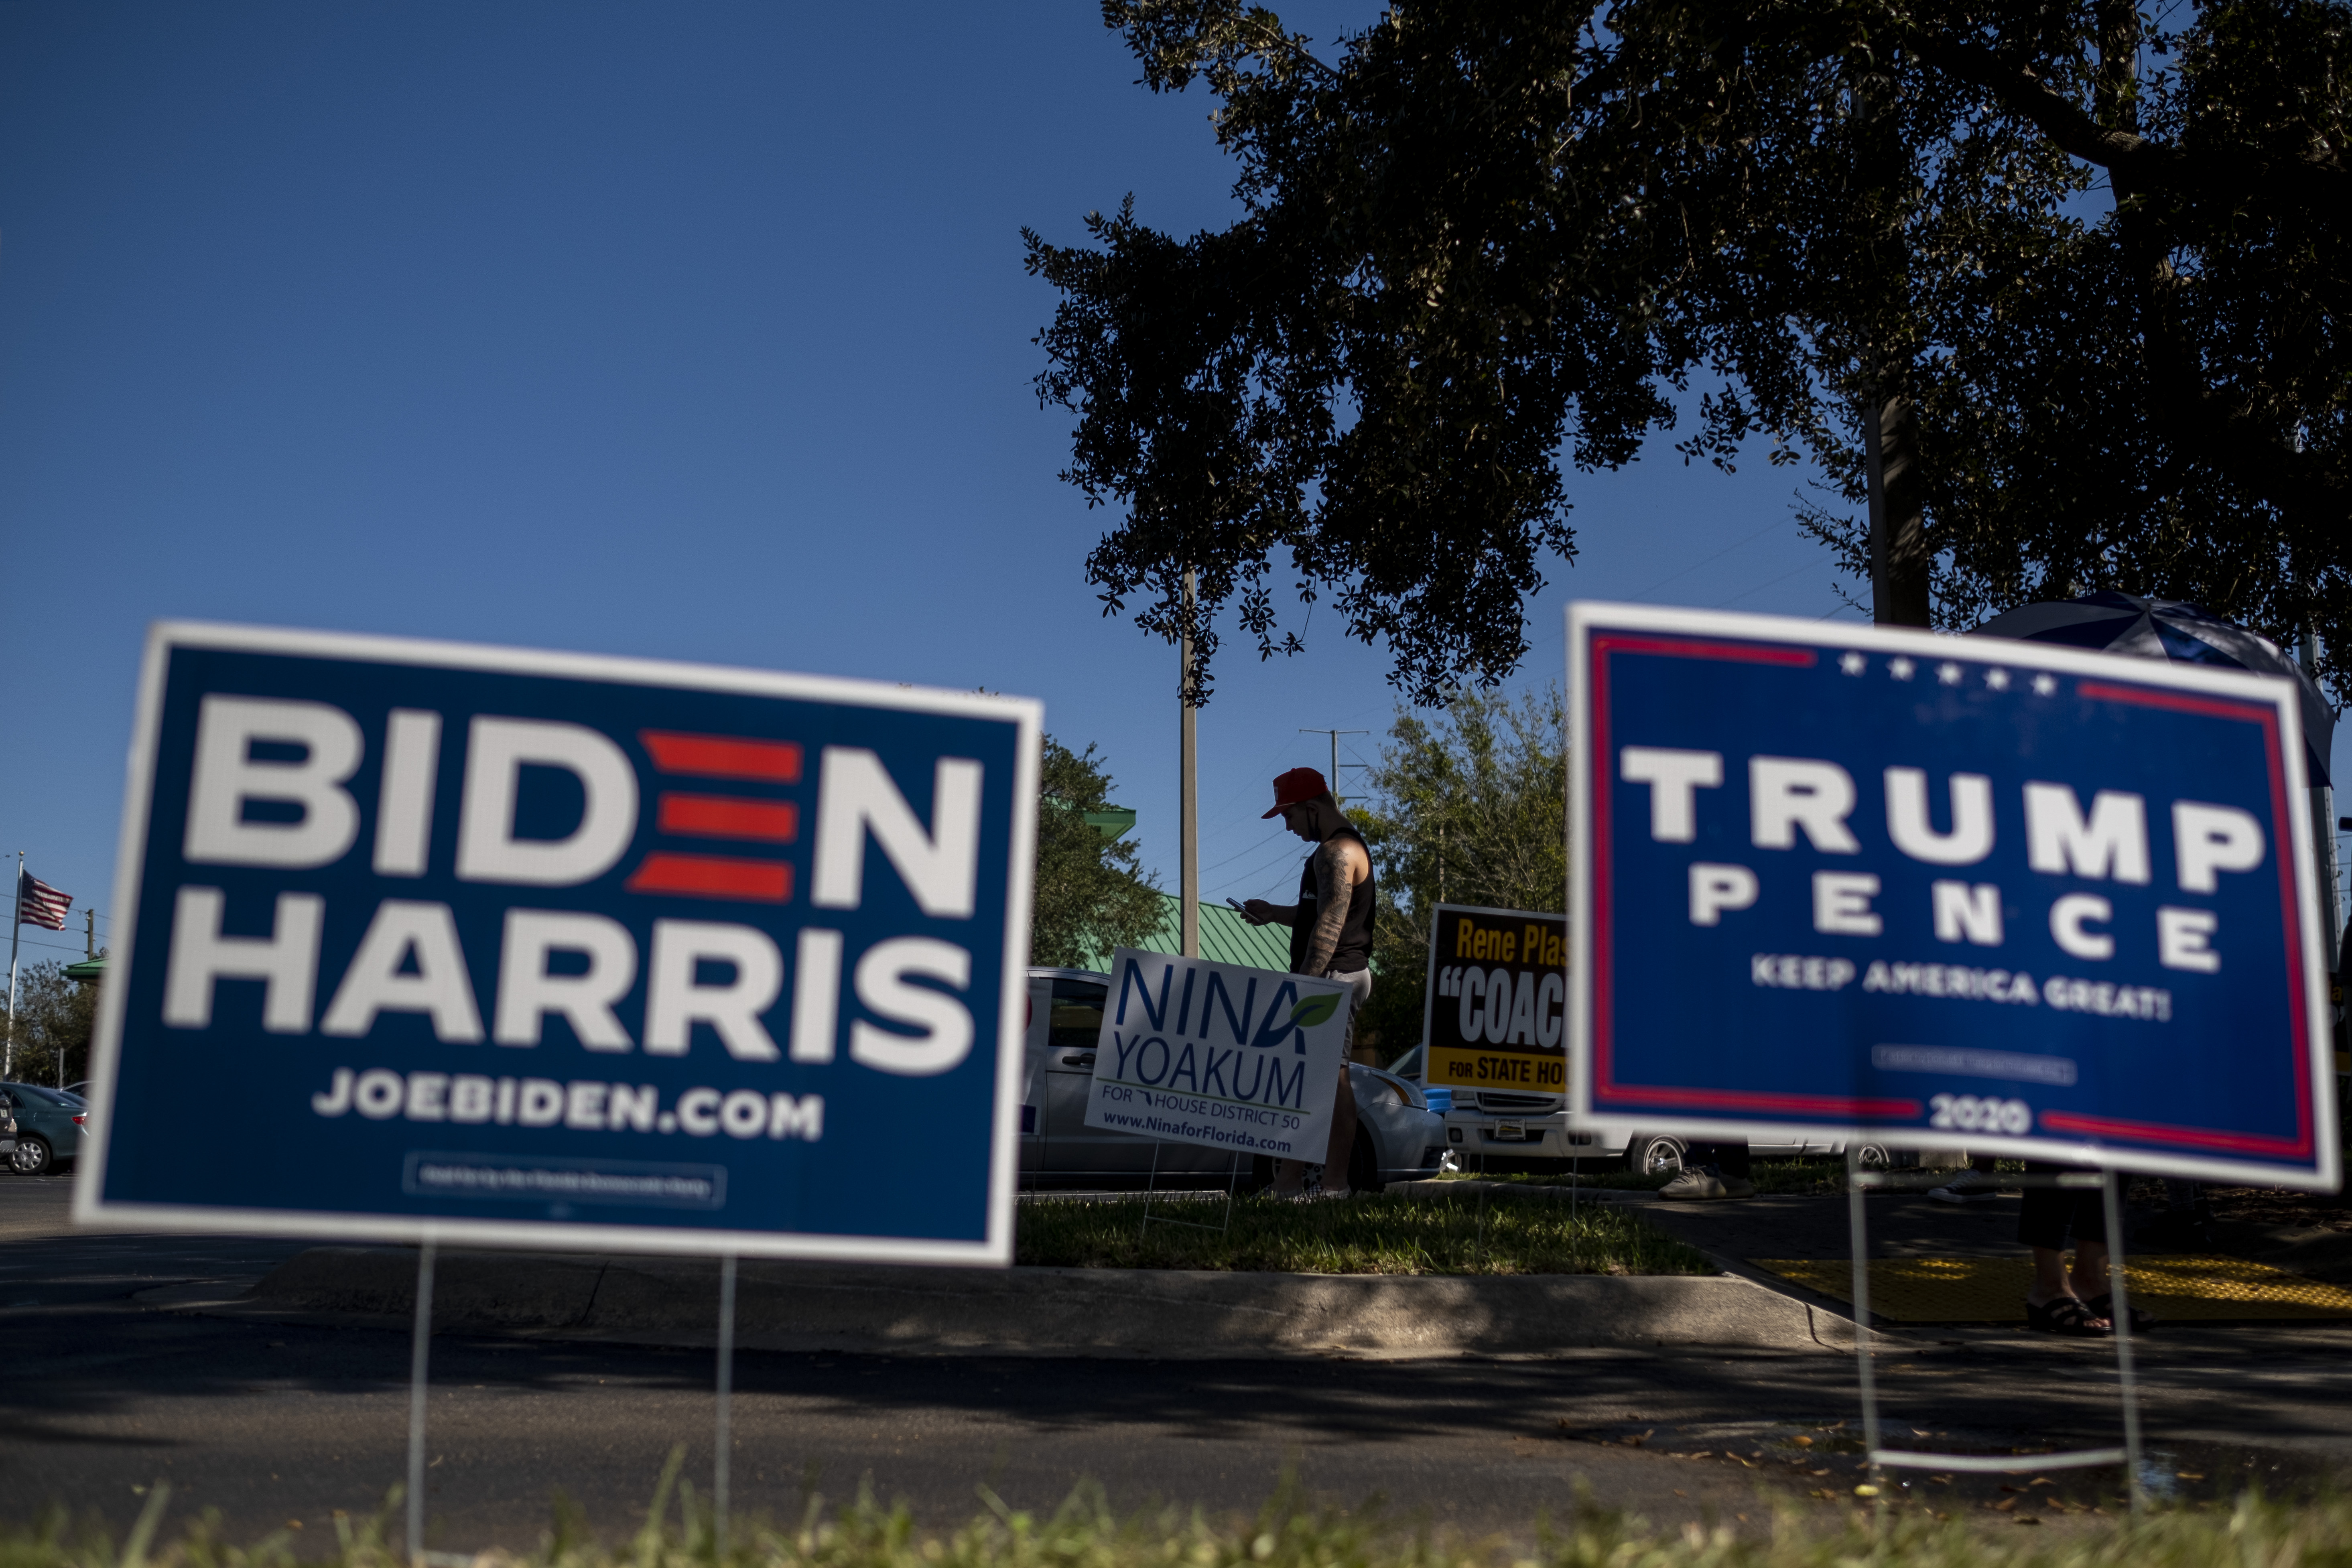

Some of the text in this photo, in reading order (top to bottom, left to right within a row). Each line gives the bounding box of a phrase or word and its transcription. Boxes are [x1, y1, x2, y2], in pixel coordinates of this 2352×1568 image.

[183, 692, 985, 920] BIDEN
[1619, 745, 2266, 895] TRUMP
[1456, 918, 1516, 962] Rene
[1688, 861, 2222, 974] PENCE
[161, 884, 977, 1077] HARRIS
[1115, 957, 1307, 1055] NINA
[1751, 953, 2172, 1022] KEEP AMERICA GREAT!
[312, 1066, 825, 1142] JOEBIDEN.COM
[1102, 1085, 1300, 1130] FOR HOUSE DISTRICT 50
[1113, 1031, 1306, 1109] YOAKUM
[1449, 1061, 1473, 1078] FOR
[1477, 1056, 1530, 1083] STATE
[1103, 1112, 1291, 1153] www.NinaforFlorida.com
[1928, 1093, 2032, 1135] 2020
